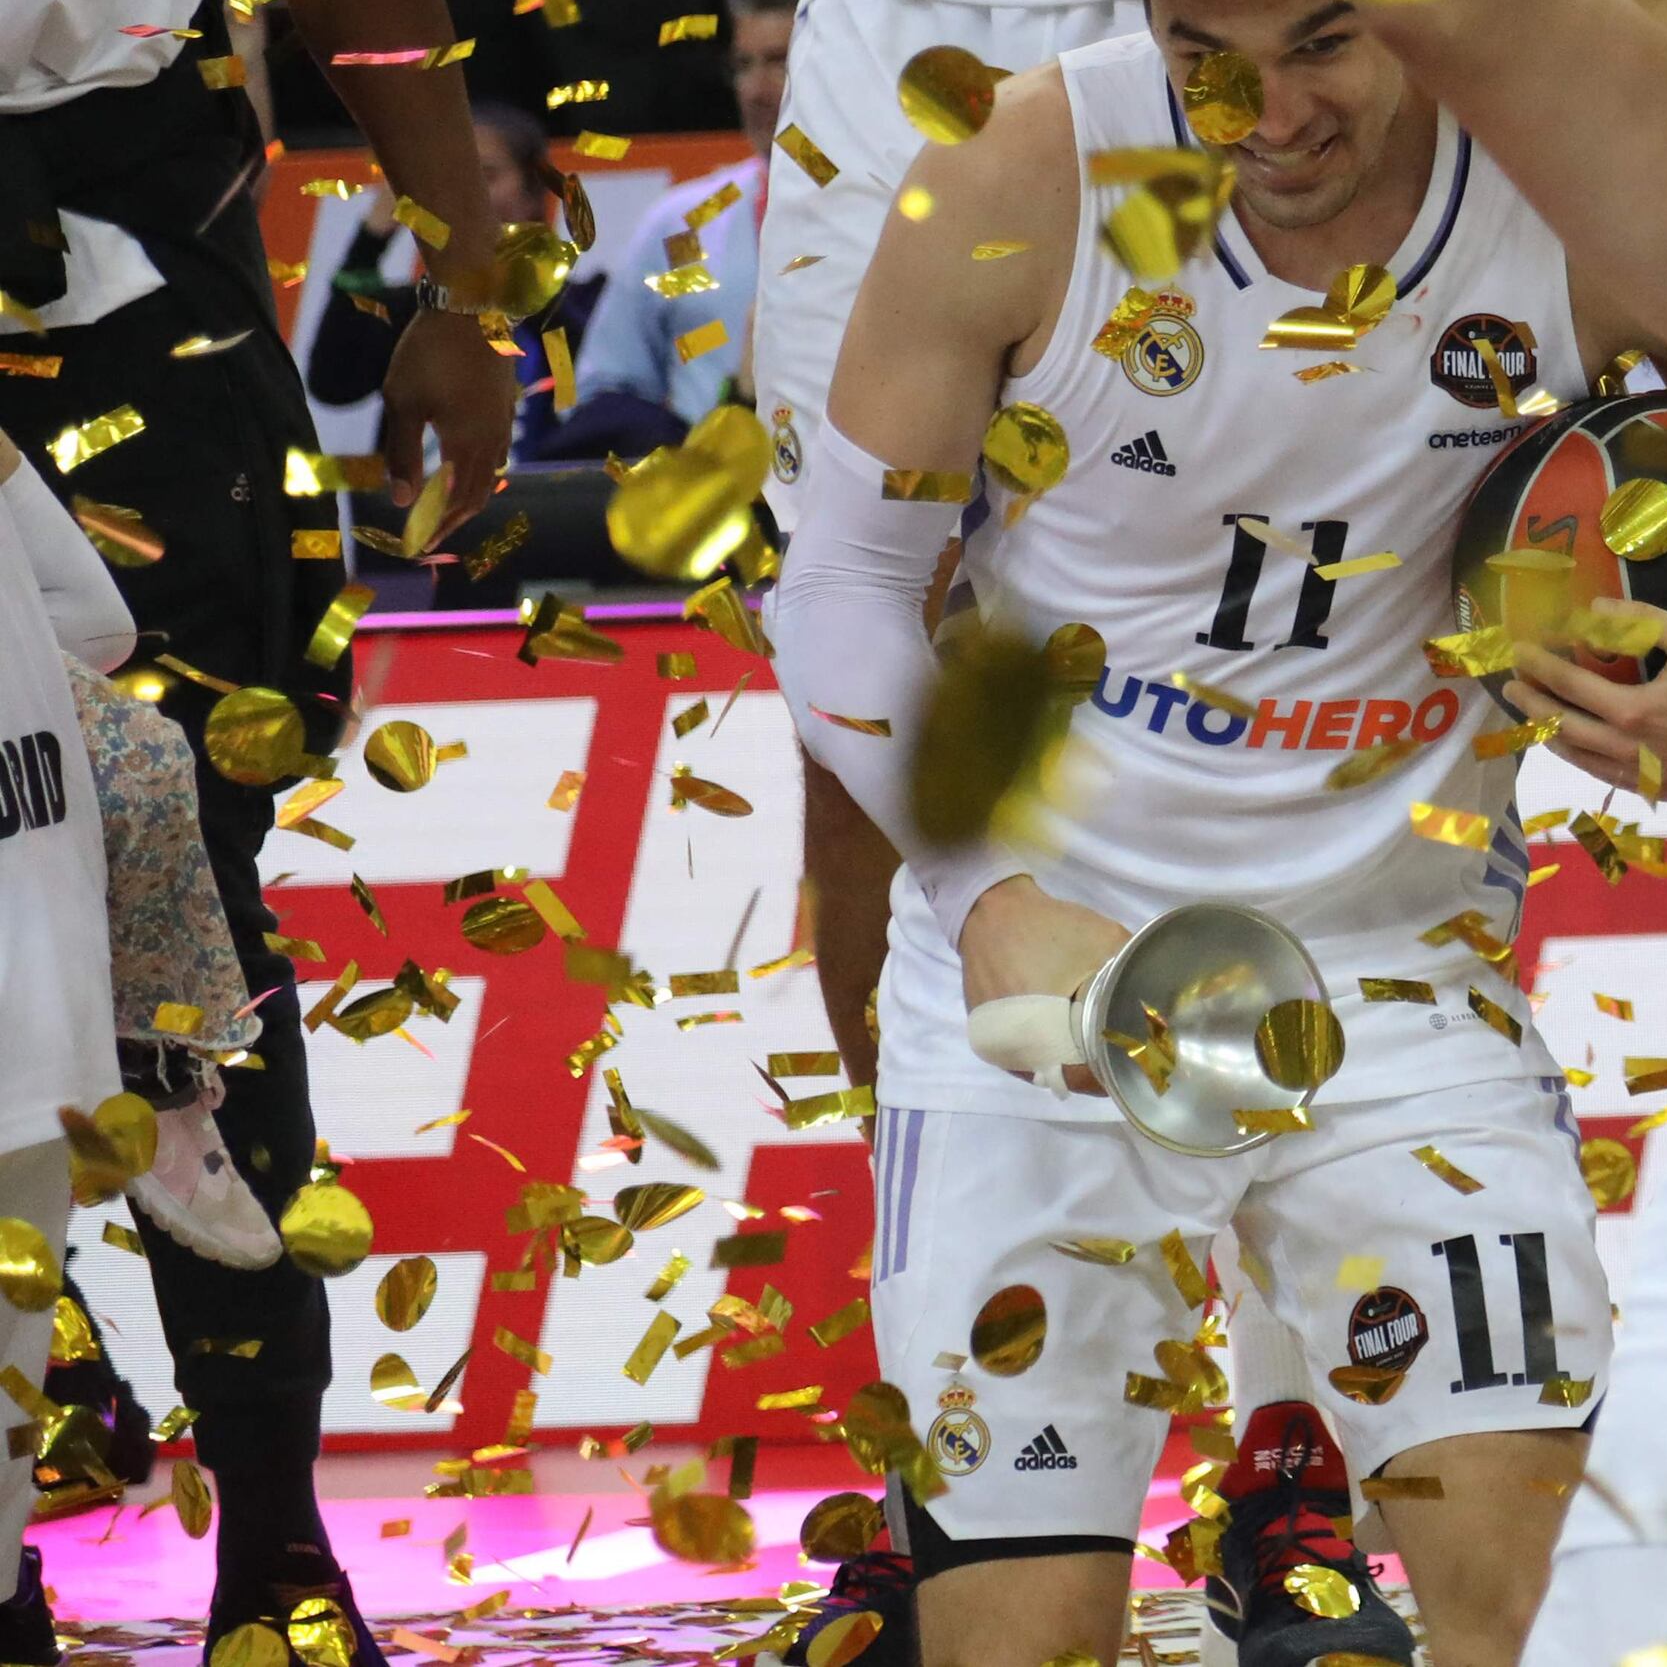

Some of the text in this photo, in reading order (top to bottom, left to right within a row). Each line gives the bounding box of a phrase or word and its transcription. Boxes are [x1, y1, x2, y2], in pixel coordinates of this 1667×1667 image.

[1443, 350, 1486, 378] FINAL
[1428, 424, 1522, 449] oneteam
[1111, 451, 1176, 477] adidas
[1196, 514, 1349, 651] 11
[1092, 664, 1460, 751] UTOHERO
[1431, 1231, 1570, 1393] 11
[1353, 1328, 1388, 1360] FINAL
[1386, 1312, 1419, 1348] FOUR
[1014, 1453, 1077, 1472] adidas
